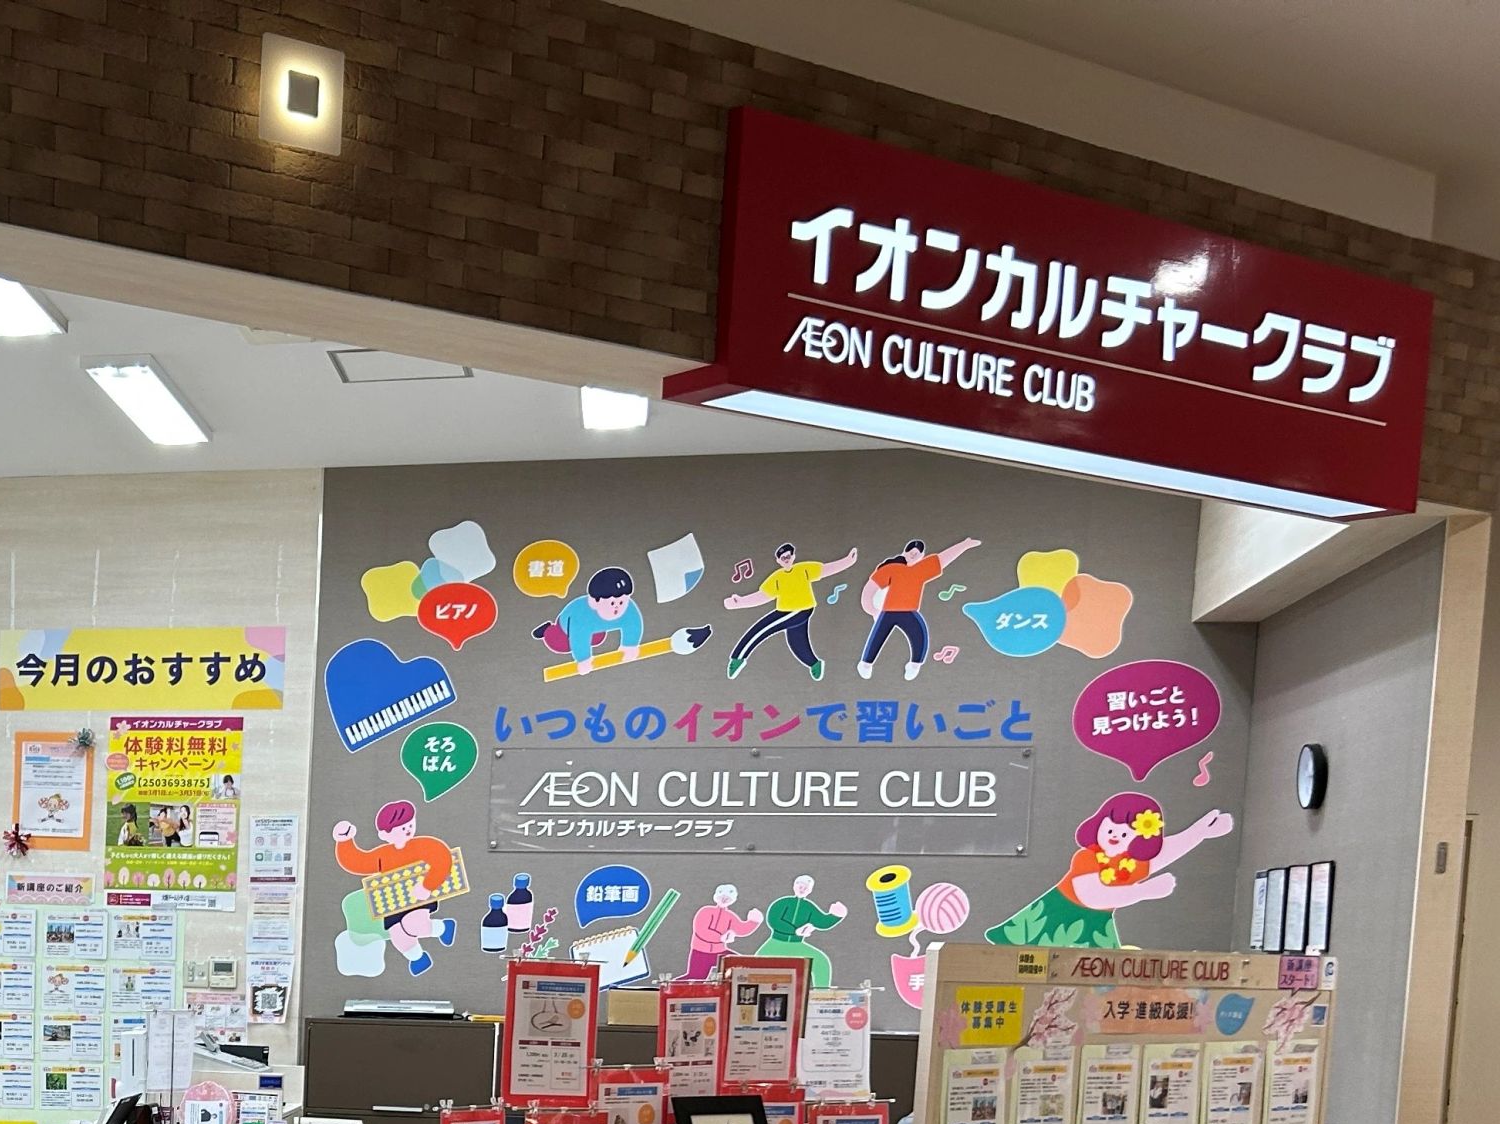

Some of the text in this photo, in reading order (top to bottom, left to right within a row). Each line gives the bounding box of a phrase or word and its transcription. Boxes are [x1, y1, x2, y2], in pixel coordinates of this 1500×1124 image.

[790, 207, 1396, 403] イオンカルチャークラブ
[882, 334, 1013, 398] CULTURE
[1023, 365, 1096, 412] CLUB
[528, 560, 564, 578] 書道
[434, 603, 478, 620] ピアノ
[995, 612, 1049, 631] ダンス
[16, 651, 267, 687] 今月のおすすめ
[1106, 687, 1187, 710] 習いごと
[132, 719, 223, 729] イオンカルチャークラブ
[494, 700, 1034, 743] いつものイオンで習いごと
[1091, 708, 1200, 737] 見つけよう!
[124, 736, 228, 756] 体験料無料
[424, 736, 456, 753] そろ
[134, 757, 216, 773] キャンペーン
[422, 756, 456, 773] ばん
[658, 771, 858, 807] CULTURE
[879, 770, 997, 807] CLUB
[516, 818, 734, 838] イオンカルチャークラブ
[16, 881, 84, 894] 新講座のご紹介
[585, 883, 640, 904] 鉛筆画
[1121, 958, 1188, 981] CULTURE
[1193, 960, 1229, 982] CLUB
[908, 974, 925, 991] 手
[960, 1000, 1019, 1015] 体験受講生
[1103, 1000, 1194, 1020] 入学・進級応援!
[972, 1016, 1005, 1029] 募集中
